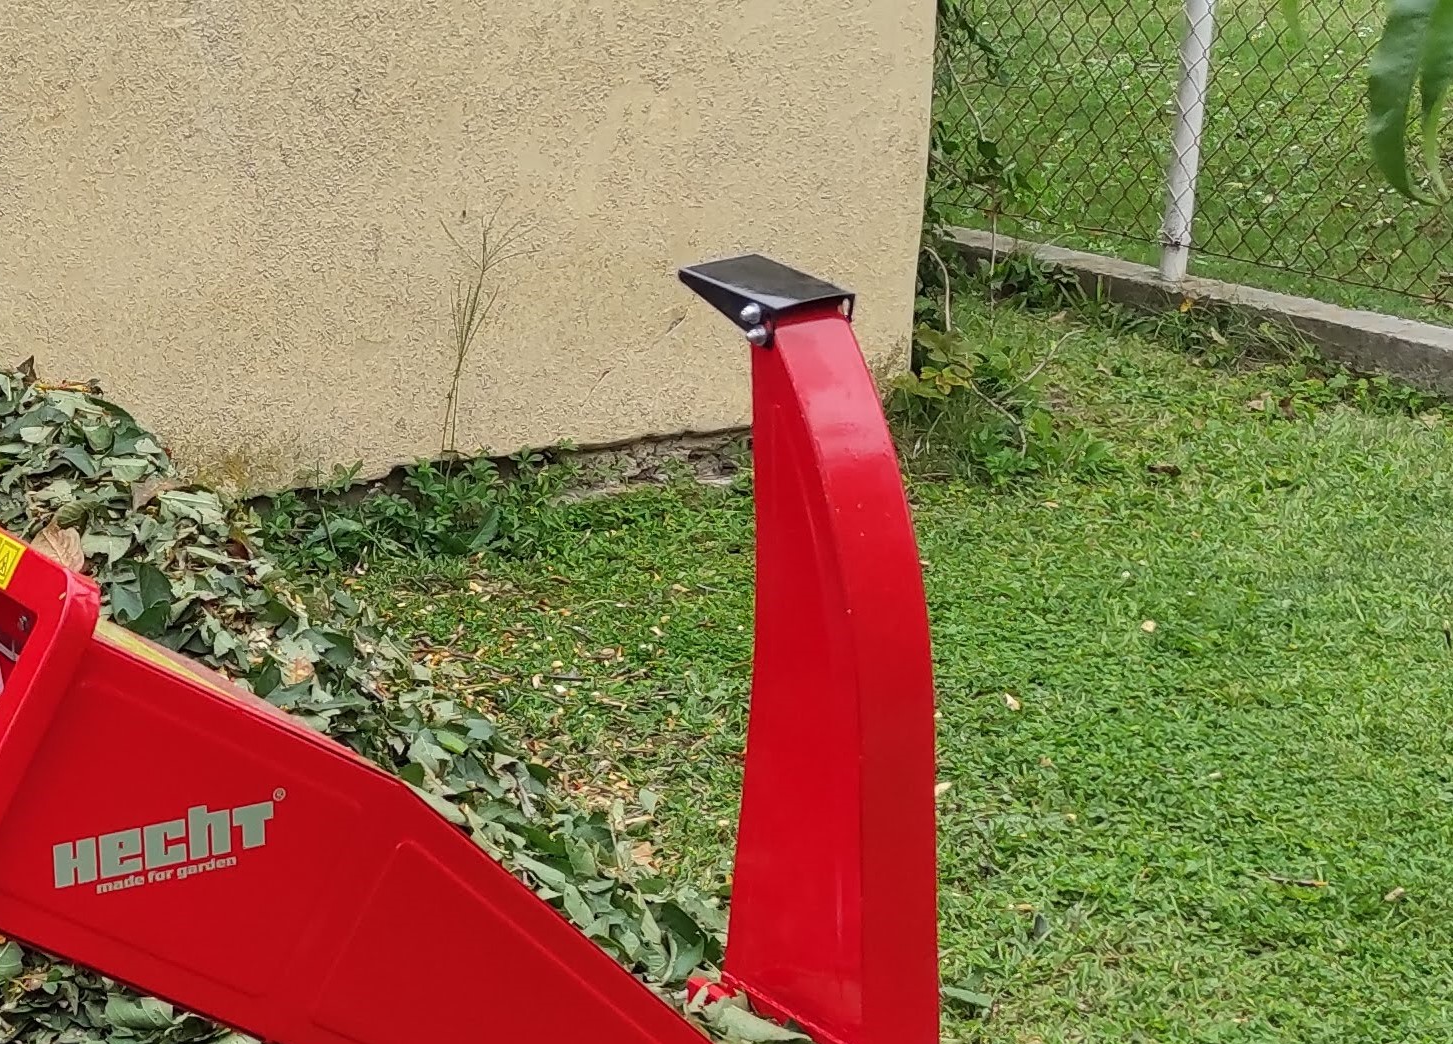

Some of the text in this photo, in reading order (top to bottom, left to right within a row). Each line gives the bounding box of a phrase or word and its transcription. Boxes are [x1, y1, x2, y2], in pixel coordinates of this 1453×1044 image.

[96, 856, 237, 894] made for garden
